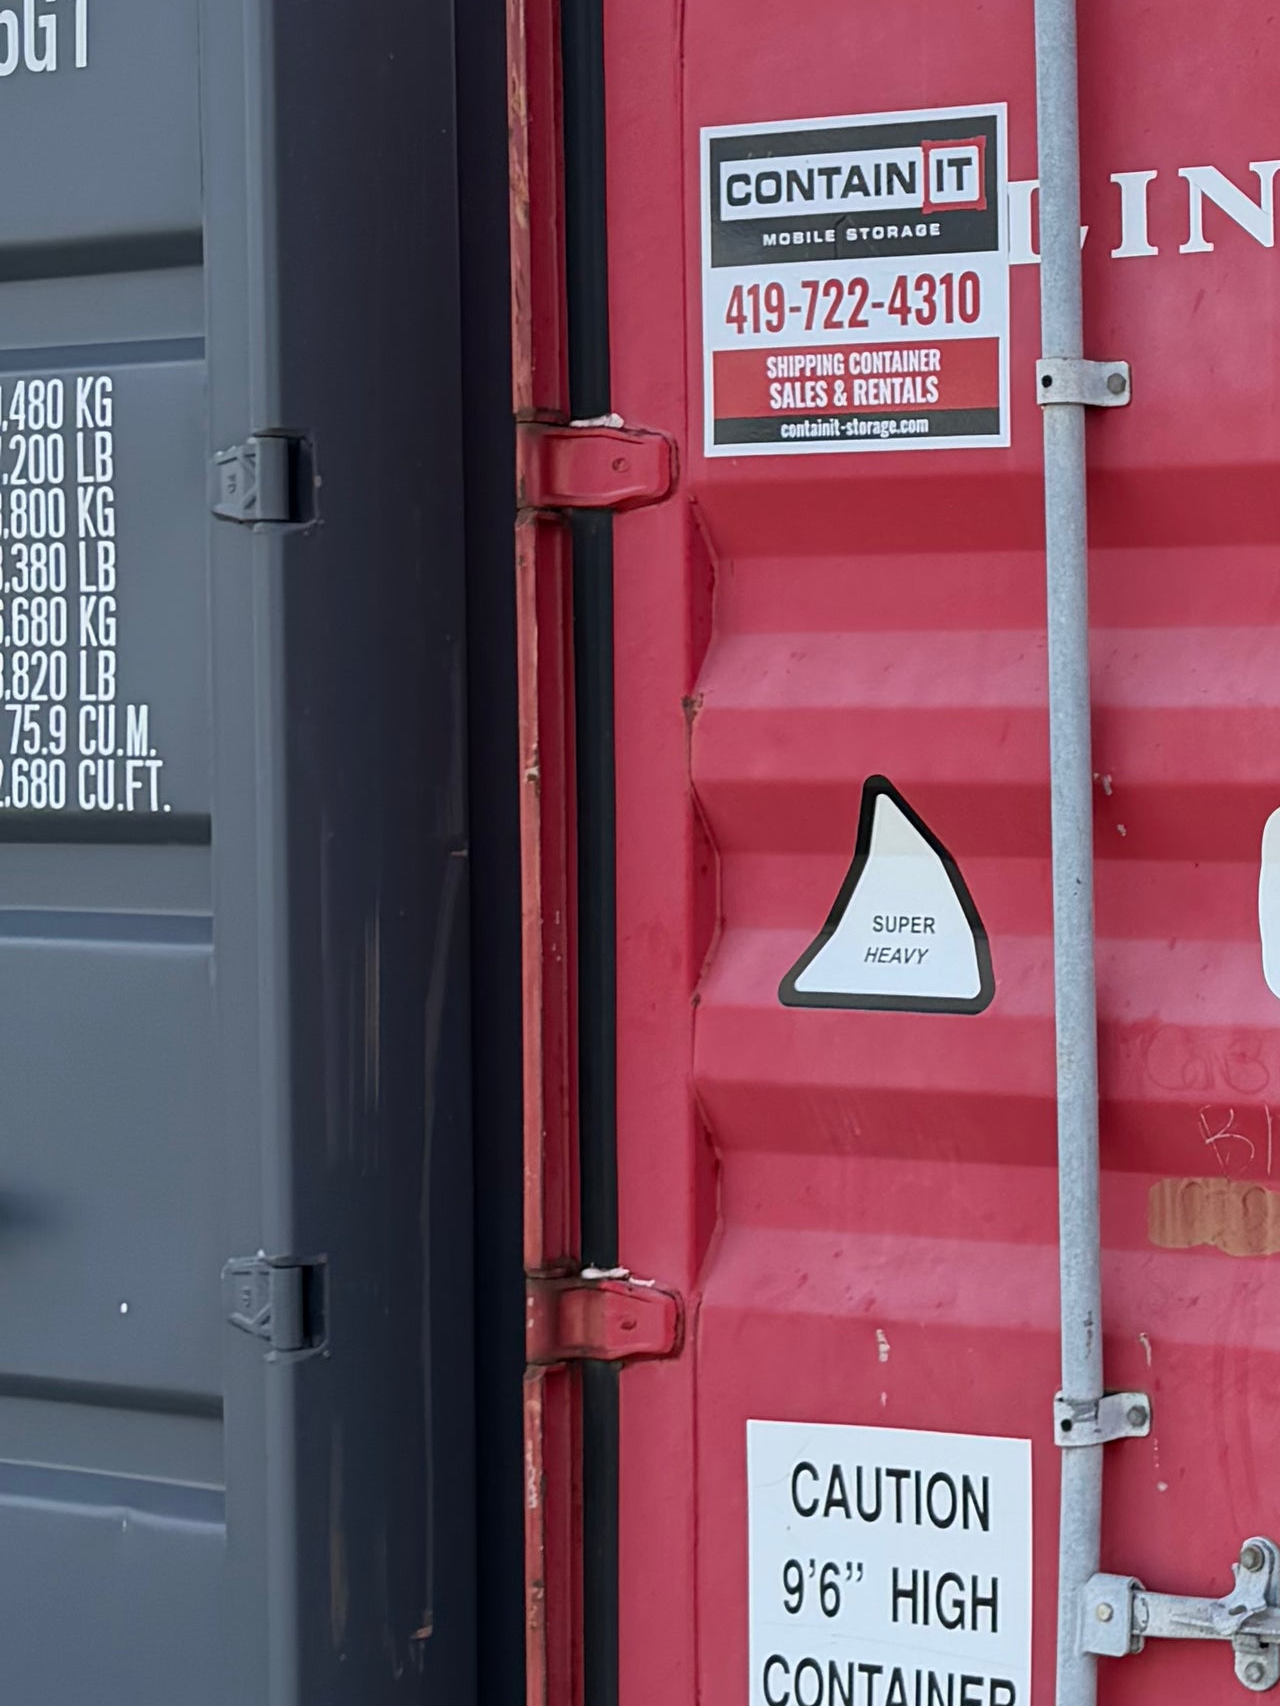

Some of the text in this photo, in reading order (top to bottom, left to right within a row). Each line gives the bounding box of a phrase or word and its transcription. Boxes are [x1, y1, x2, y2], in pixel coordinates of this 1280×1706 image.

[727, 161, 916, 206] CONTAIN
[763, 223, 940, 246] MOBILE STORAGE
[725, 271, 980, 334] 419-722-4310
[766, 349, 940, 379] SHIPPING CONTAINER
[76, 376, 113, 428] KG
[769, 376, 938, 409] SALES & RENTALS
[781, 418, 929, 438] containit-storage.com
[76, 431, 113, 483] LB
[78, 486, 115, 538] KG
[79, 541, 116, 592] LB
[80, 595, 116, 646] KG
[80, 650, 116, 701] LB
[5, 704, 157, 756] 75.9 CU.M.
[78, 759, 171, 812] CU.FT.
[872, 915, 936, 934] SUPER
[864, 946, 929, 965] HEAVY
[791, 1461, 990, 1532] CAUTION
[892, 1567, 998, 1633] HIGH
